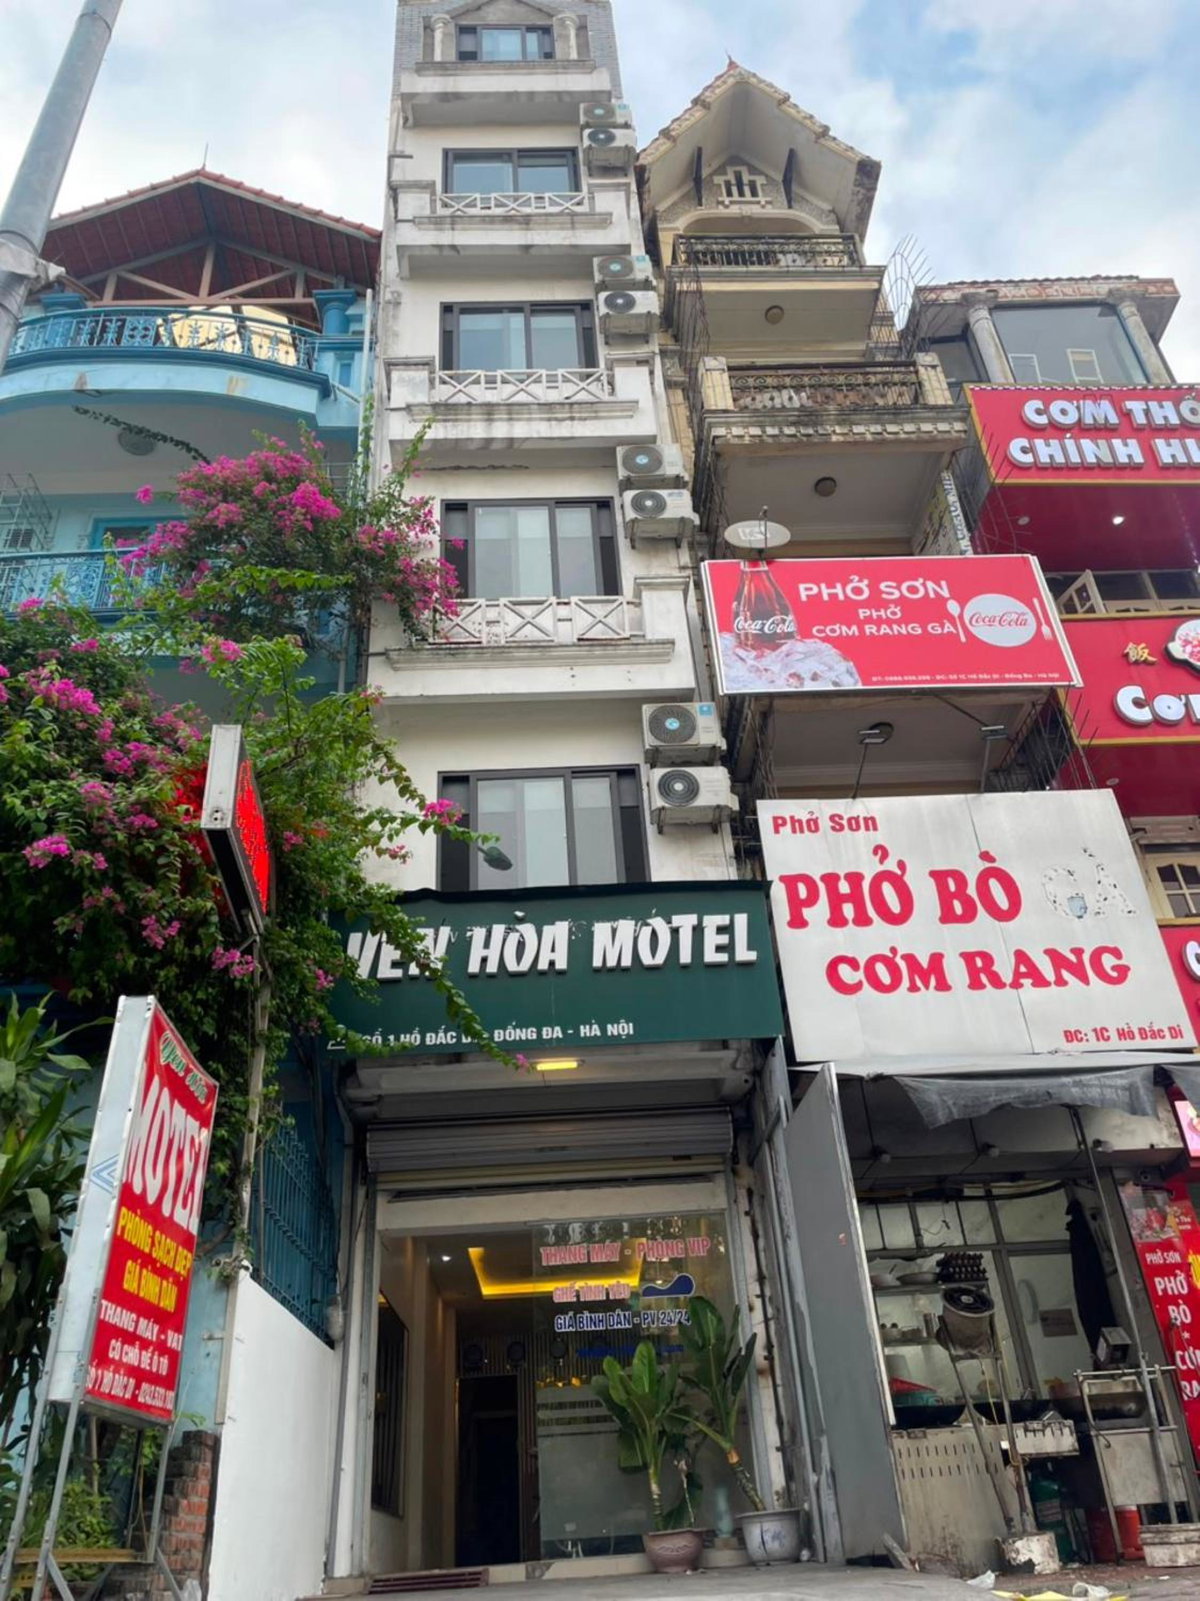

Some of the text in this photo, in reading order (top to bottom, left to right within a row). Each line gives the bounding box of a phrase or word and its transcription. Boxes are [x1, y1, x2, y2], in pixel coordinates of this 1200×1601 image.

[1022, 398, 1120, 428] CƠM
[1007, 432, 1145, 469] CHÍNH
[798, 574, 951, 602] PHỞ SƠN
[733, 614, 797, 635] Coca-Cola
[857, 603, 902, 620] PHỞ
[967, 610, 1030, 628] Coca-Cola
[812, 619, 958, 638] CƠM RANG GÀ
[772, 811, 879, 835] Phở Sơn
[778, 844, 914, 930] PHỞ
[929, 850, 1023, 925] BÒ
[467, 910, 569, 976] HÒA
[592, 912, 757, 970] MOTEL
[825, 946, 952, 996] CƠM
[960, 946, 1131, 991] RANG
[425, 1024, 457, 1045] ĐẮC
[493, 1020, 537, 1042] ĐỐNG
[542, 1026, 563, 1039] ĐA
[580, 1019, 601, 1037] HÀ
[607, 1019, 634, 1038] NỘI
[1091, 1026, 1111, 1042] 1C
[1137, 1021, 1166, 1040] Đắc
[540, 1243, 587, 1266] THANG
[590, 1239, 621, 1262] MÁY
[635, 1236, 685, 1258] PHÒNG
[688, 1236, 711, 1257] VIP
[1145, 1249, 1181, 1264] PHỞ SƠN
[1154, 1270, 1188, 1296] PHỞ
[100, 1298, 137, 1332] THANG
[136, 1316, 160, 1342] MÁY
[555, 1312, 576, 1332] GIÁ
[577, 1311, 607, 1330] BÌNH
[608, 1309, 632, 1329] DÂN
[641, 1311, 658, 1328] PV
[659, 1309, 692, 1327] 24/24
[1168, 1299, 1192, 1326] BÒ
